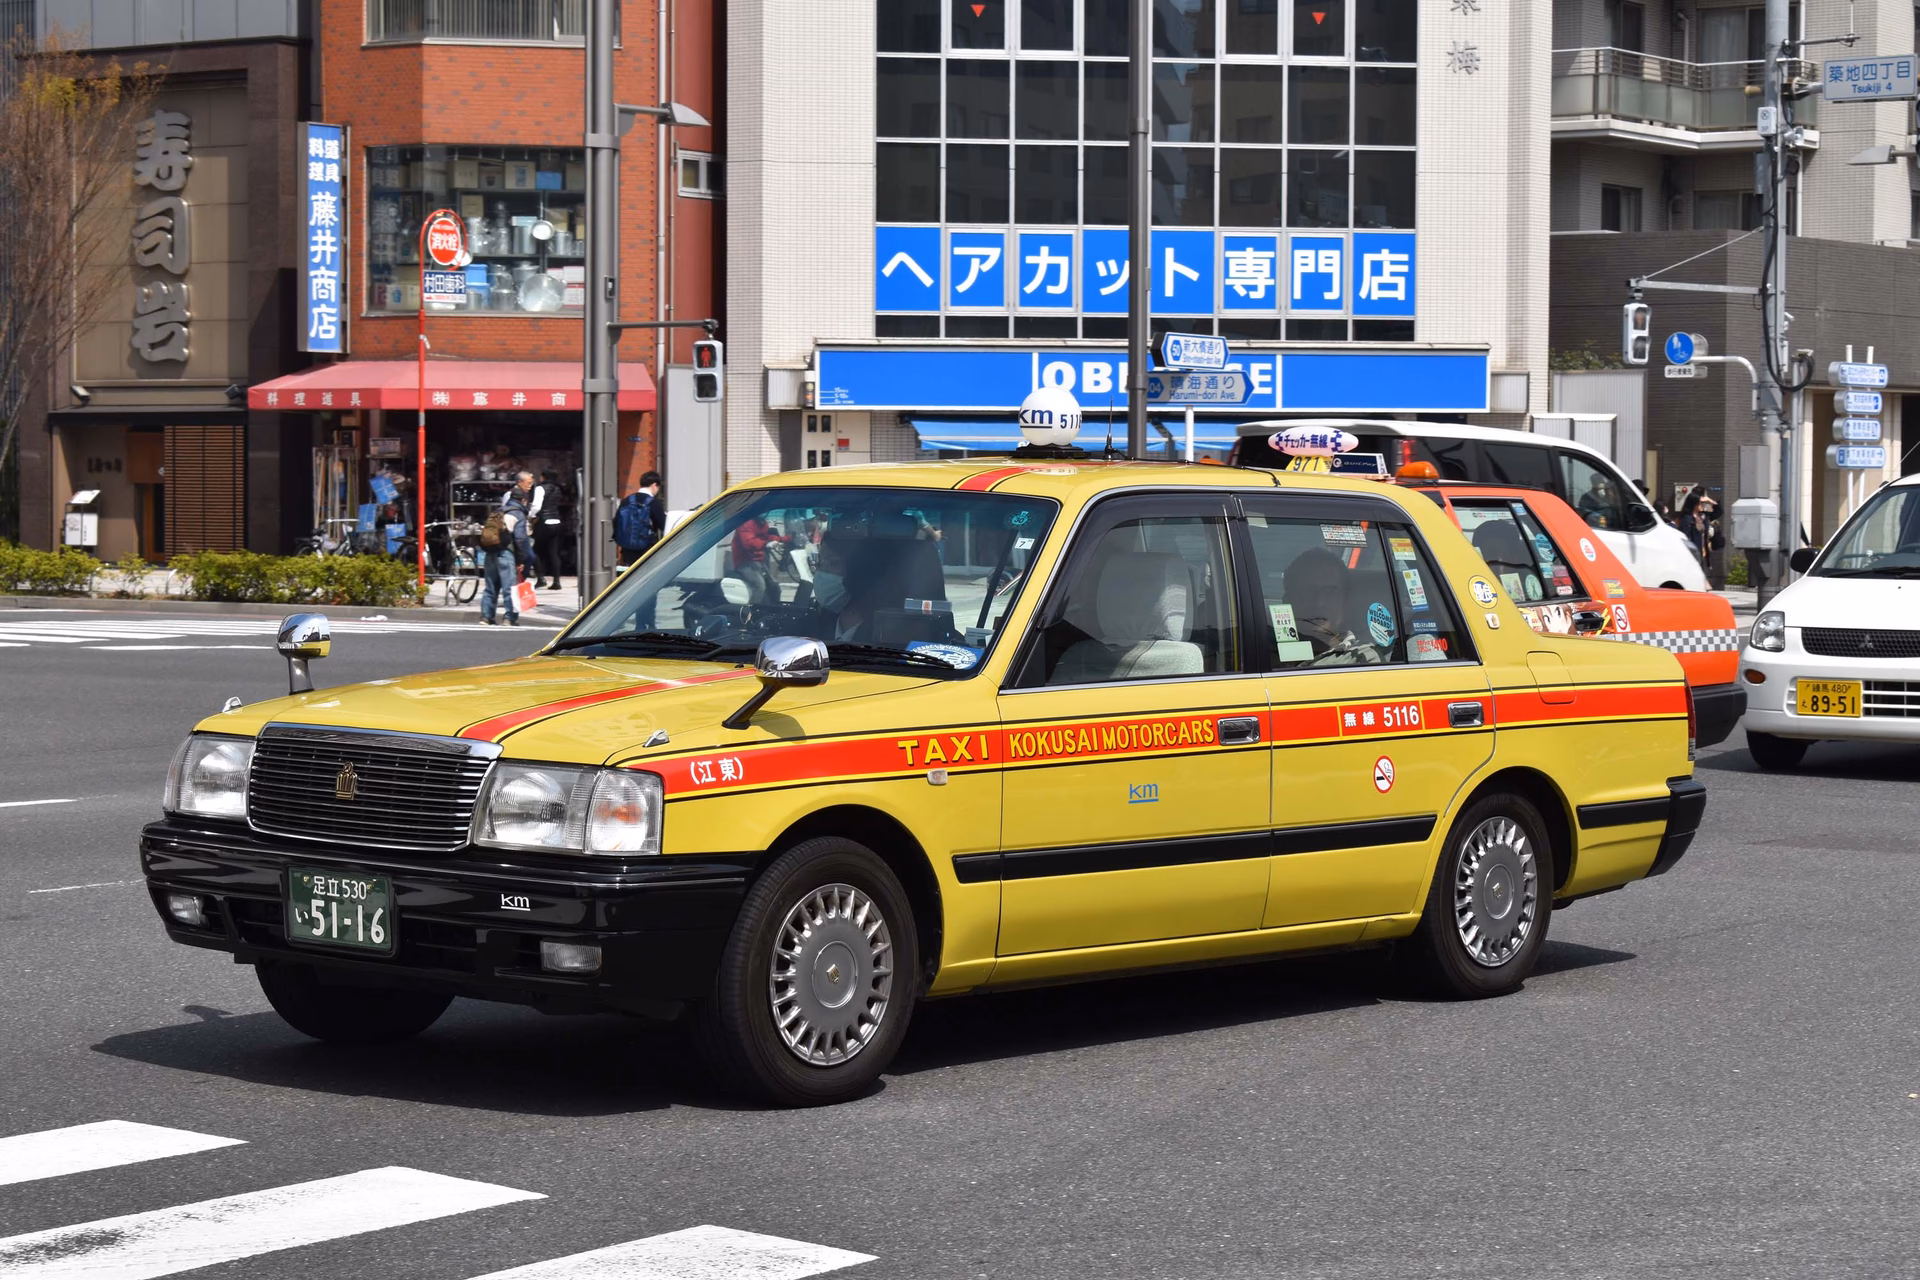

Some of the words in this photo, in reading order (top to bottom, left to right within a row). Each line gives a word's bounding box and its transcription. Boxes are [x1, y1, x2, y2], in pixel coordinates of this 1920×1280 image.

[1829, 61, 1910, 83] 築地四丁目
[1851, 84, 1881, 93] Tsukiji
[1885, 82, 1892, 91] 4
[431, 232, 458, 251] 消火栓
[309, 191, 339, 341] 藤井商店
[881, 246, 1409, 301] ヘアカット専門店
[425, 273, 465, 294] 村田歯科
[1170, 376, 1235, 390] 晴海通り
[267, 391, 361, 406] 料理道具
[1169, 391, 1217, 400] Harumi-dori
[1284, 434, 1328, 448] チェッカー無線
[1294, 456, 1320, 471] 971
[1831, 684, 1848, 694] 480
[1811, 695, 1855, 714] 89-51
[1344, 711, 1375, 727] 無線
[1383, 705, 1420, 727] 5116
[1009, 728, 1099, 758] KOKUSAI
[1101, 719, 1214, 750] MOTORCARS
[898, 734, 989, 765] TAXI
[690, 756, 744, 785] (江東)
[1128, 783, 1159, 802] km
[313, 876, 340, 897] 足立
[342, 879, 367, 900] 530
[501, 893, 530, 909] km
[295, 908, 308, 923] い
[311, 899, 385, 944] 51-16
